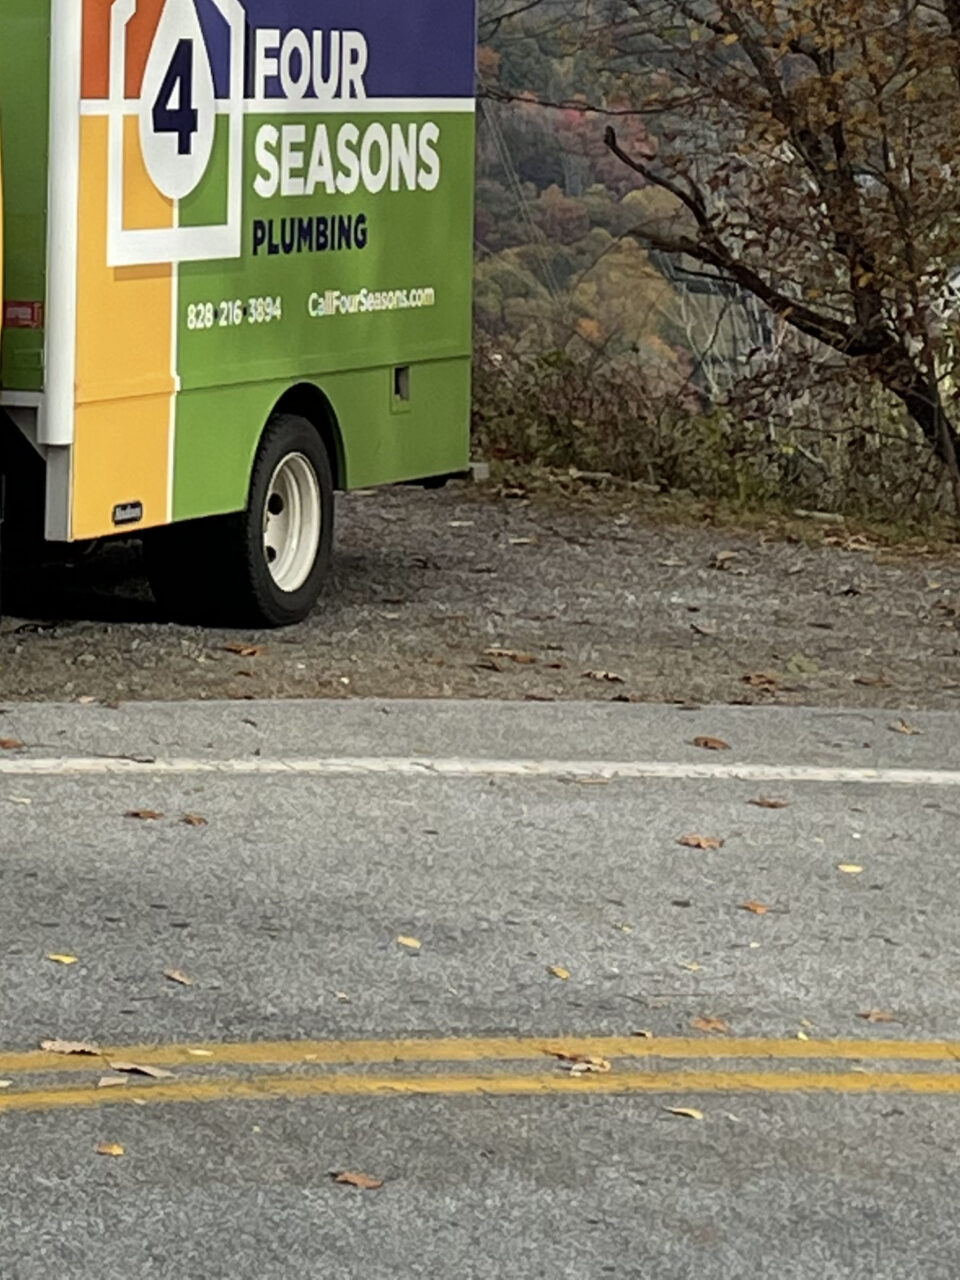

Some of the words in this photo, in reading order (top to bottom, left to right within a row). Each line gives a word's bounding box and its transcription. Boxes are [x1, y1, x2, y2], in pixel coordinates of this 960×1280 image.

[152, 38, 198, 156] 4
[255, 28, 368, 100] FOUR
[253, 122, 440, 198] SEASONS
[252, 213, 368, 256] PLUMBING
[308, 287, 435, 317] CallFourSeasons.com
